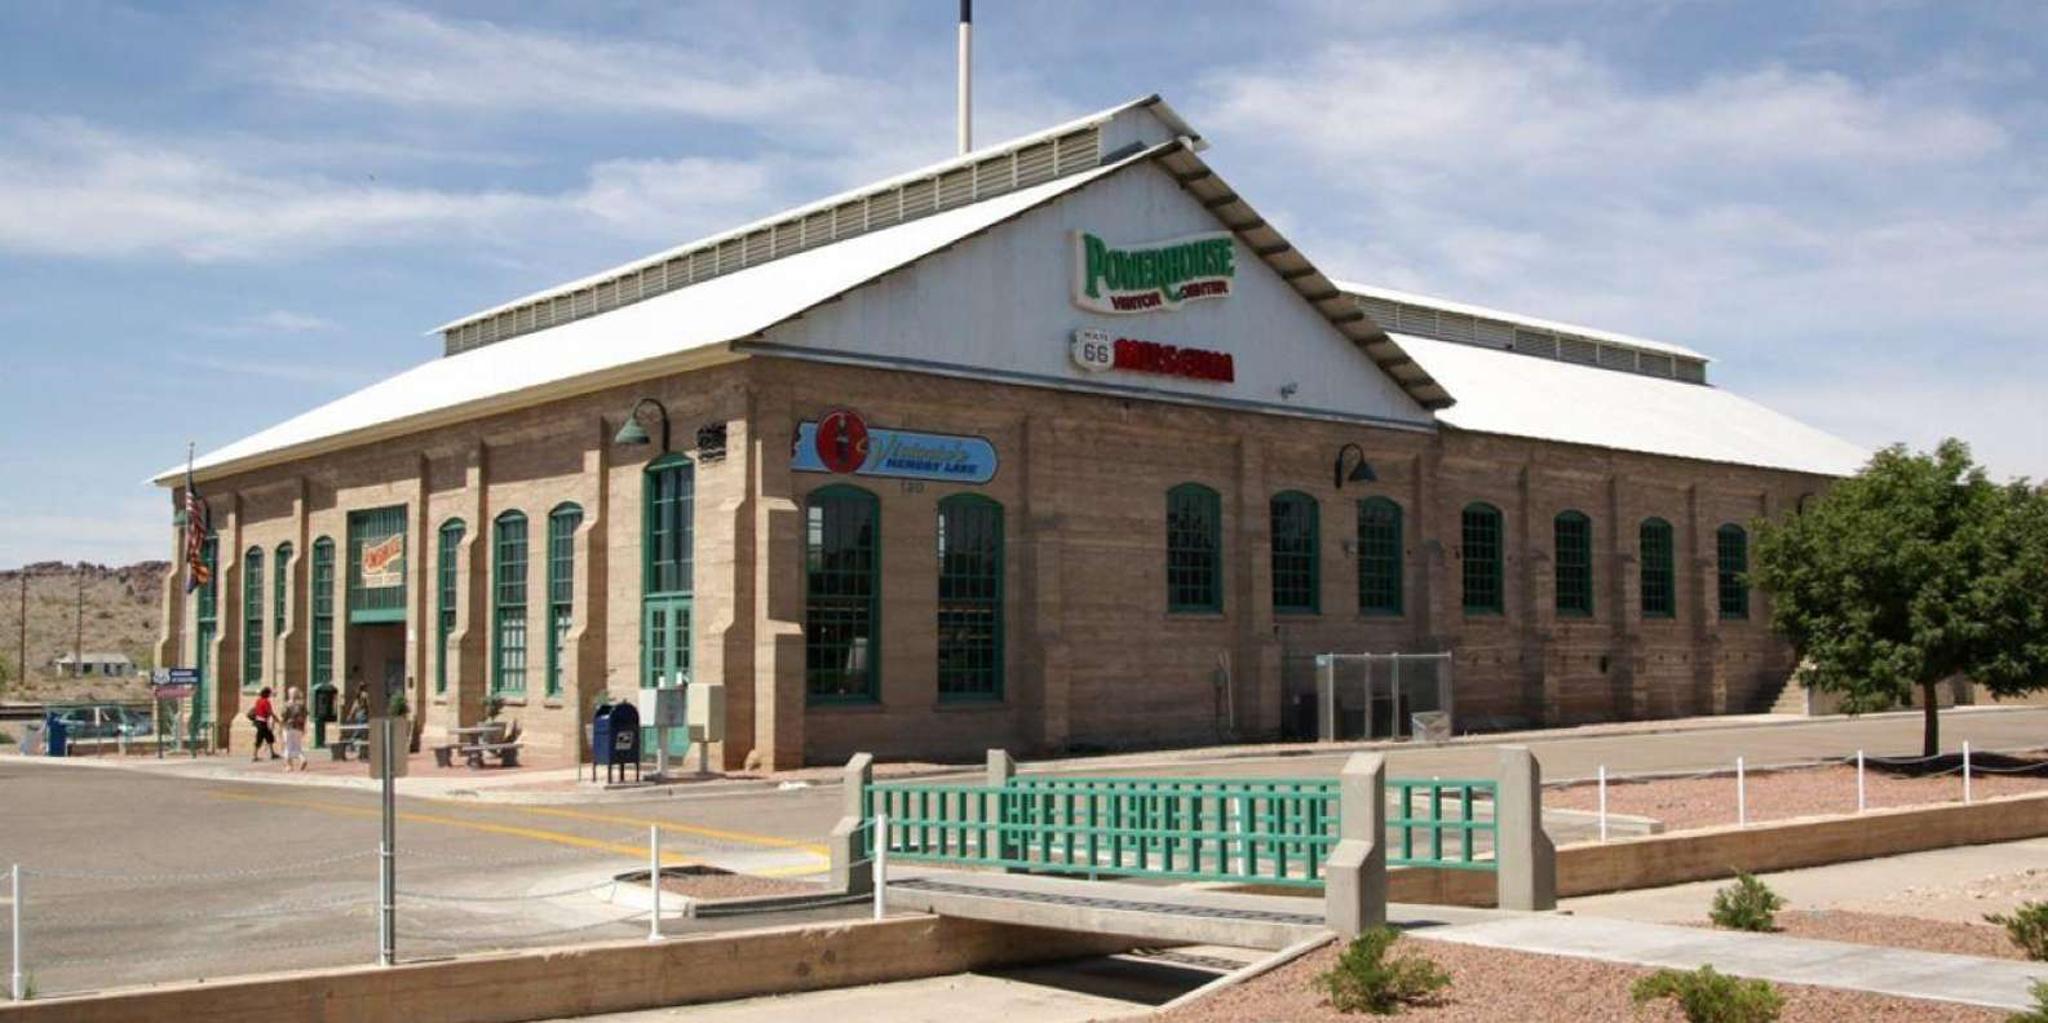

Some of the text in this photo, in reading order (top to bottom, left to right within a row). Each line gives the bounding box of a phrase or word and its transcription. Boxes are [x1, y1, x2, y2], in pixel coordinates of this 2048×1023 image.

[1083, 233, 1235, 302] POWERHOUSE
[1178, 280, 1229, 299] CENTER
[1083, 342, 1109, 363] 66
[944, 462, 979, 473] LANE
